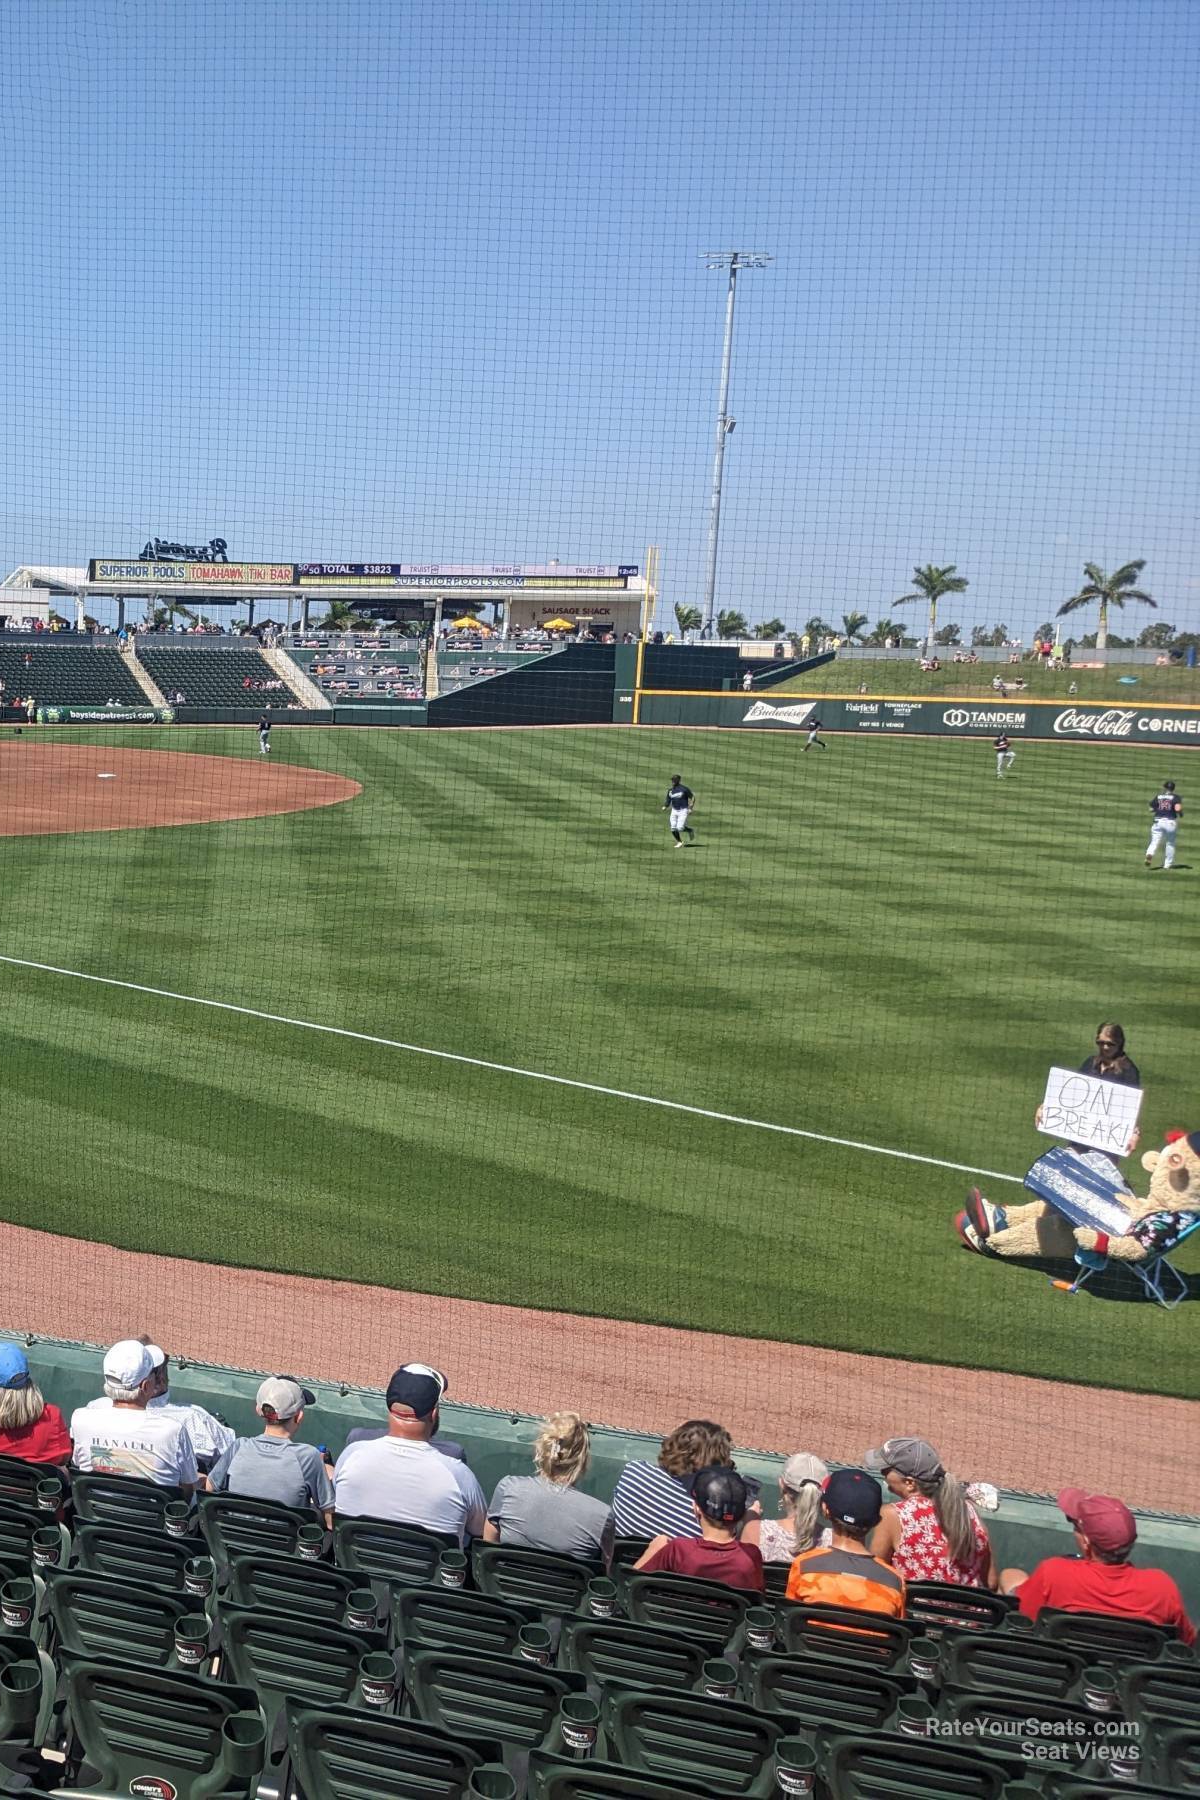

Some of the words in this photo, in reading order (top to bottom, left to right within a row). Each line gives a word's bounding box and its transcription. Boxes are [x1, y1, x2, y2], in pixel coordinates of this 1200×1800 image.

[99, 564, 150, 578] SUPERIOR
[153, 566, 185, 579] POOLS
[190, 567, 243, 580] TOMAHAWK
[248, 568, 266, 580] TIKI
[270, 569, 291, 581] BAR
[322, 564, 355, 574] TOTAL:
[363, 565, 392, 575] $3823
[394, 576, 526, 587] SUPERIORPOOLS.COM
[542, 607, 580, 615] SAUSAGE
[582, 608, 611, 616] SHACK
[750, 705, 809, 718] Budweiser
[970, 711, 1027, 723] TANDEM
[1137, 718, 1200, 734] CORNE
[1058, 1076, 1114, 1116] ON
[1043, 1106, 1129, 1149] BREAK!
